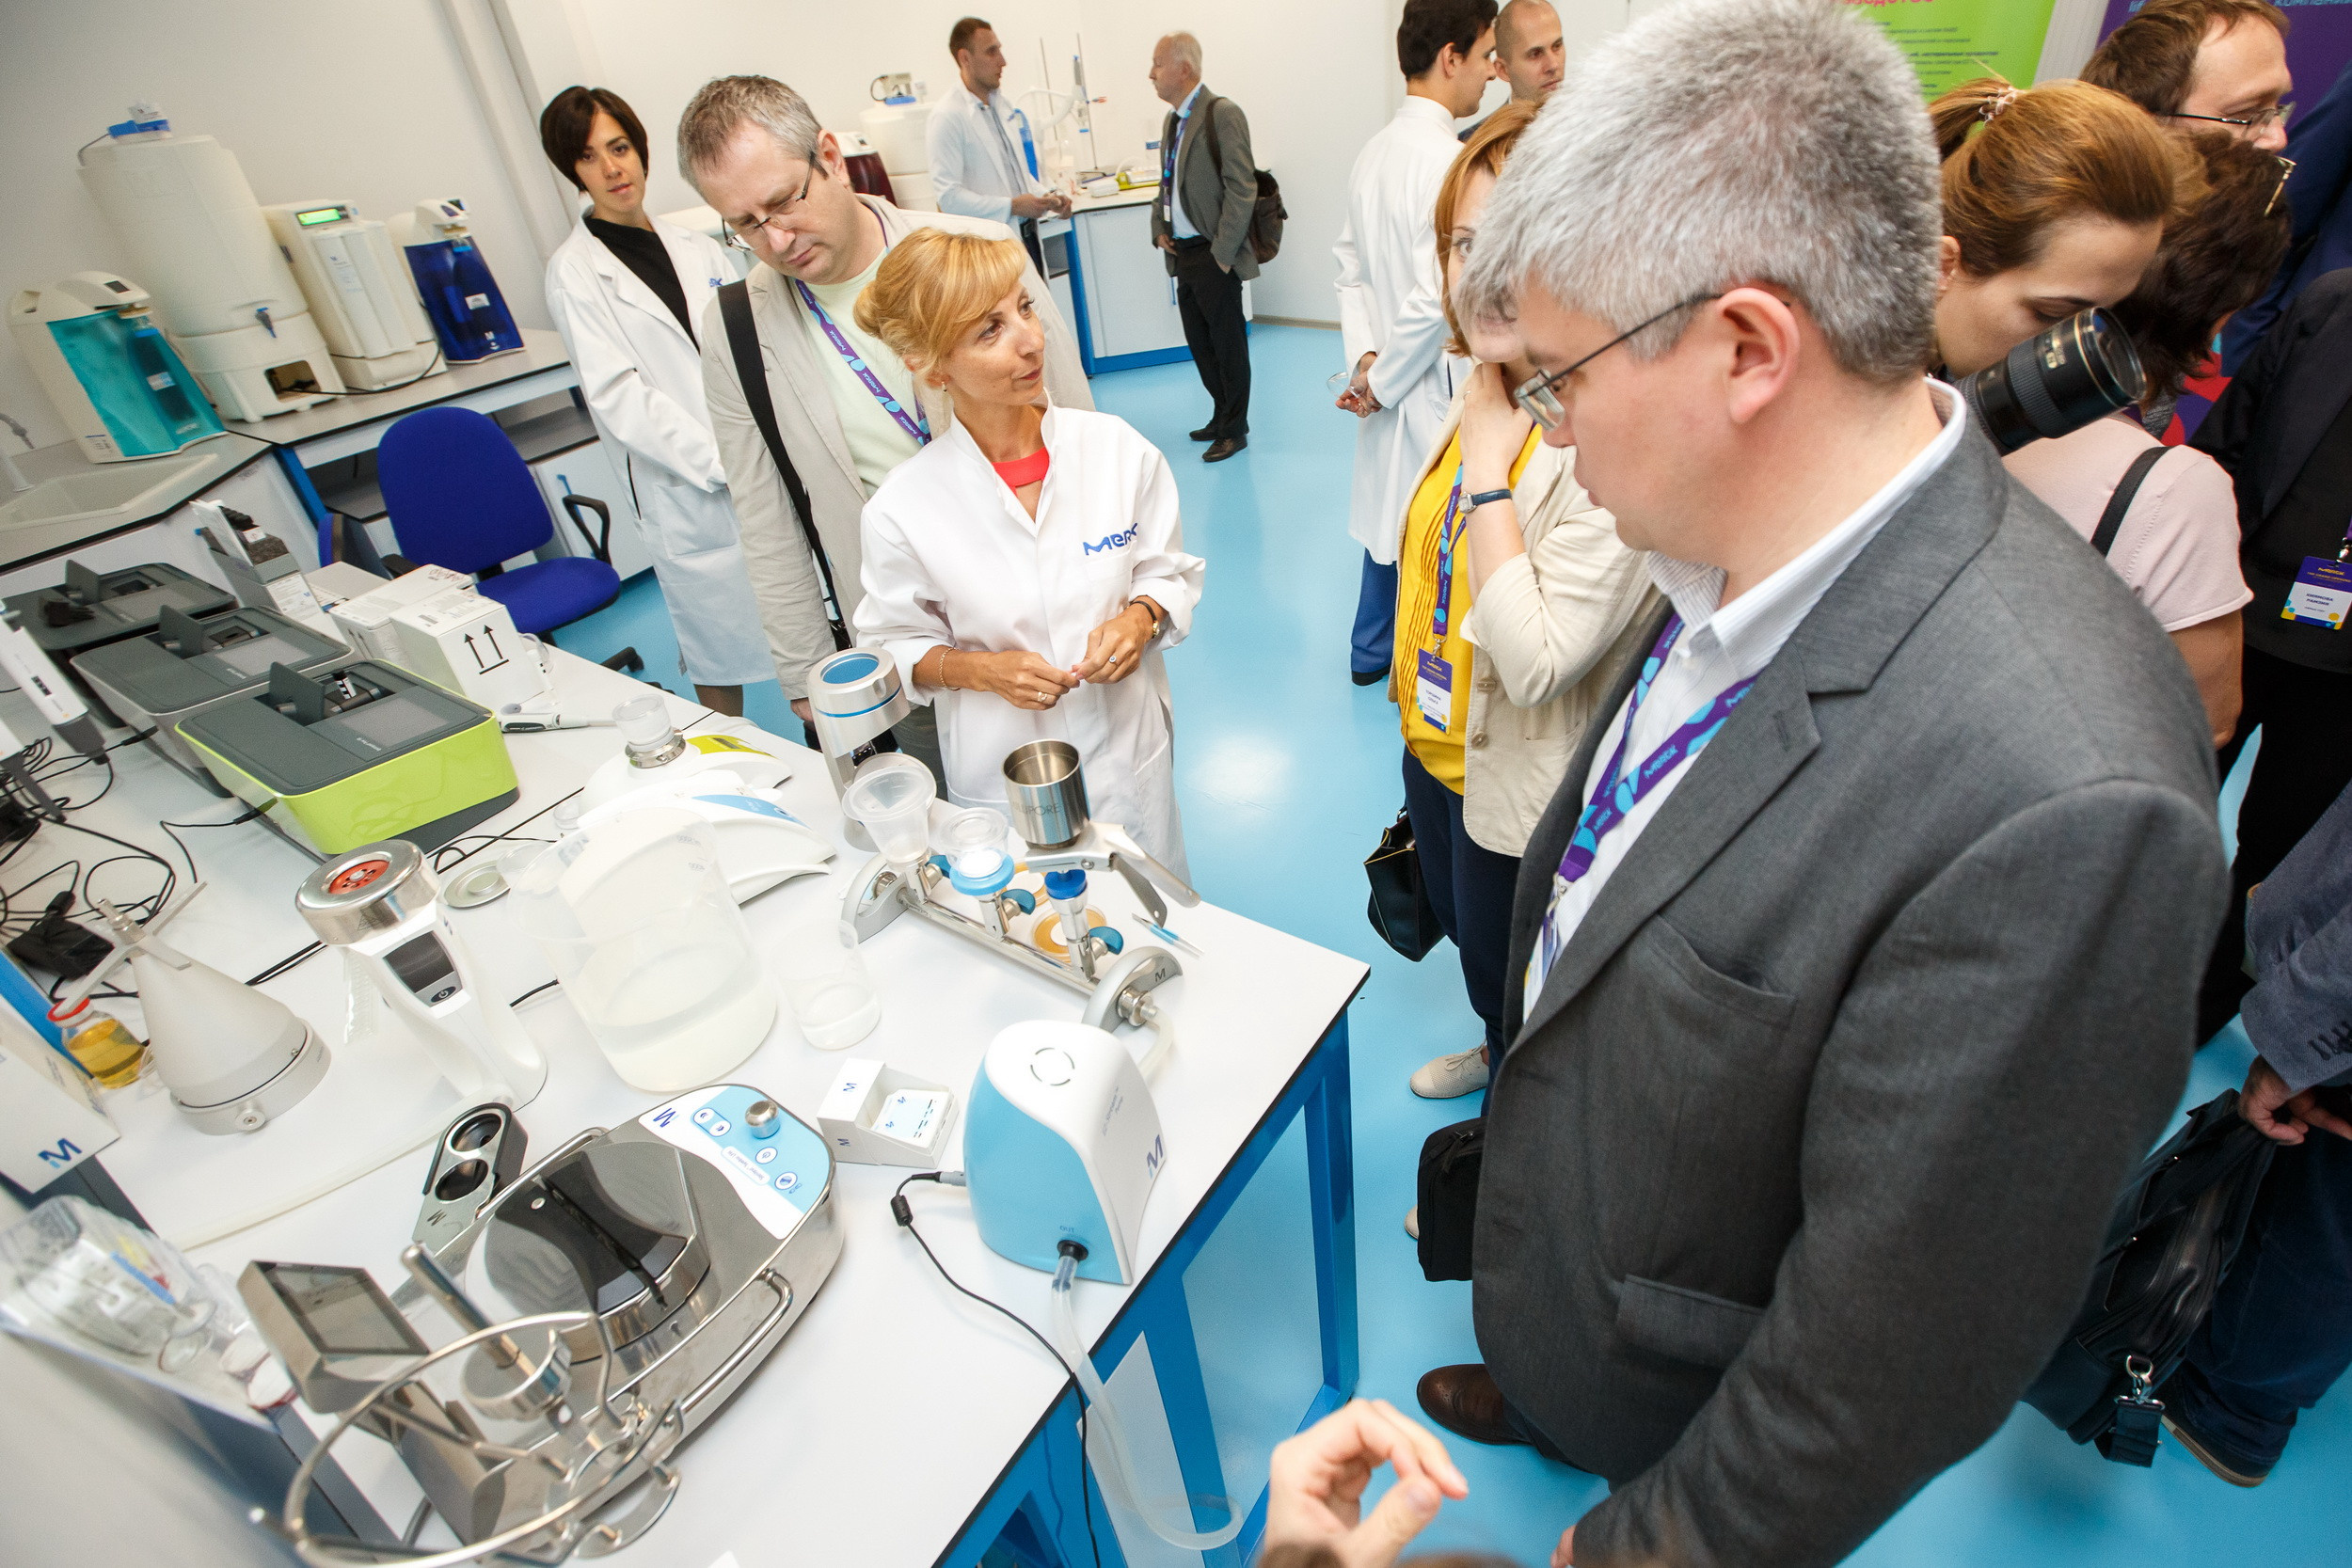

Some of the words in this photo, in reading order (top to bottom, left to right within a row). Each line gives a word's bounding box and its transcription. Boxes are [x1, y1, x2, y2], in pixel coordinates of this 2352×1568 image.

[1645, 745, 1678, 779] MERCK
[1155, 968, 1166, 982] M
[38, 1138, 83, 1169] M
[1146, 1133, 1165, 1179] M
